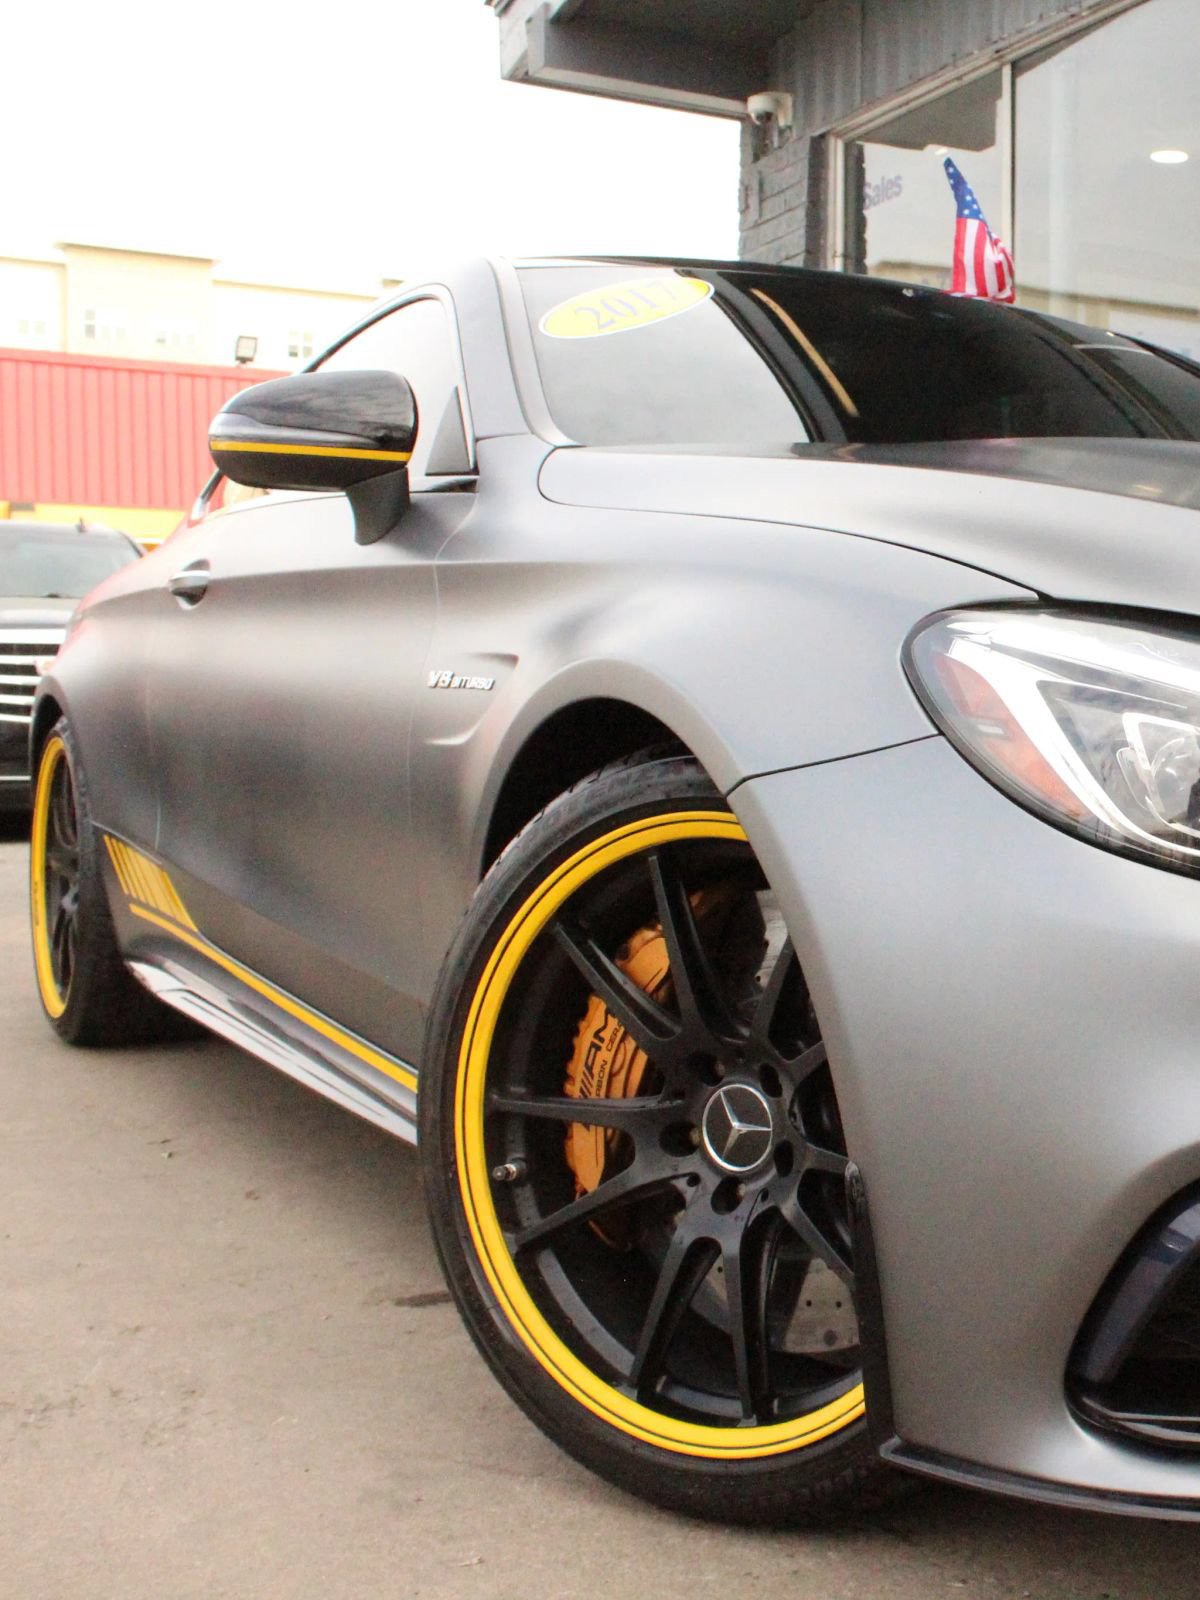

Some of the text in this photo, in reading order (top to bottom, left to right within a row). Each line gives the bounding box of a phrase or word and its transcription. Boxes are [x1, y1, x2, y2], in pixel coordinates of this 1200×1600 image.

[864, 174, 903, 211] Sales
[574, 279, 677, 330] 2017
[428, 670, 496, 691] V8 BITURBO
